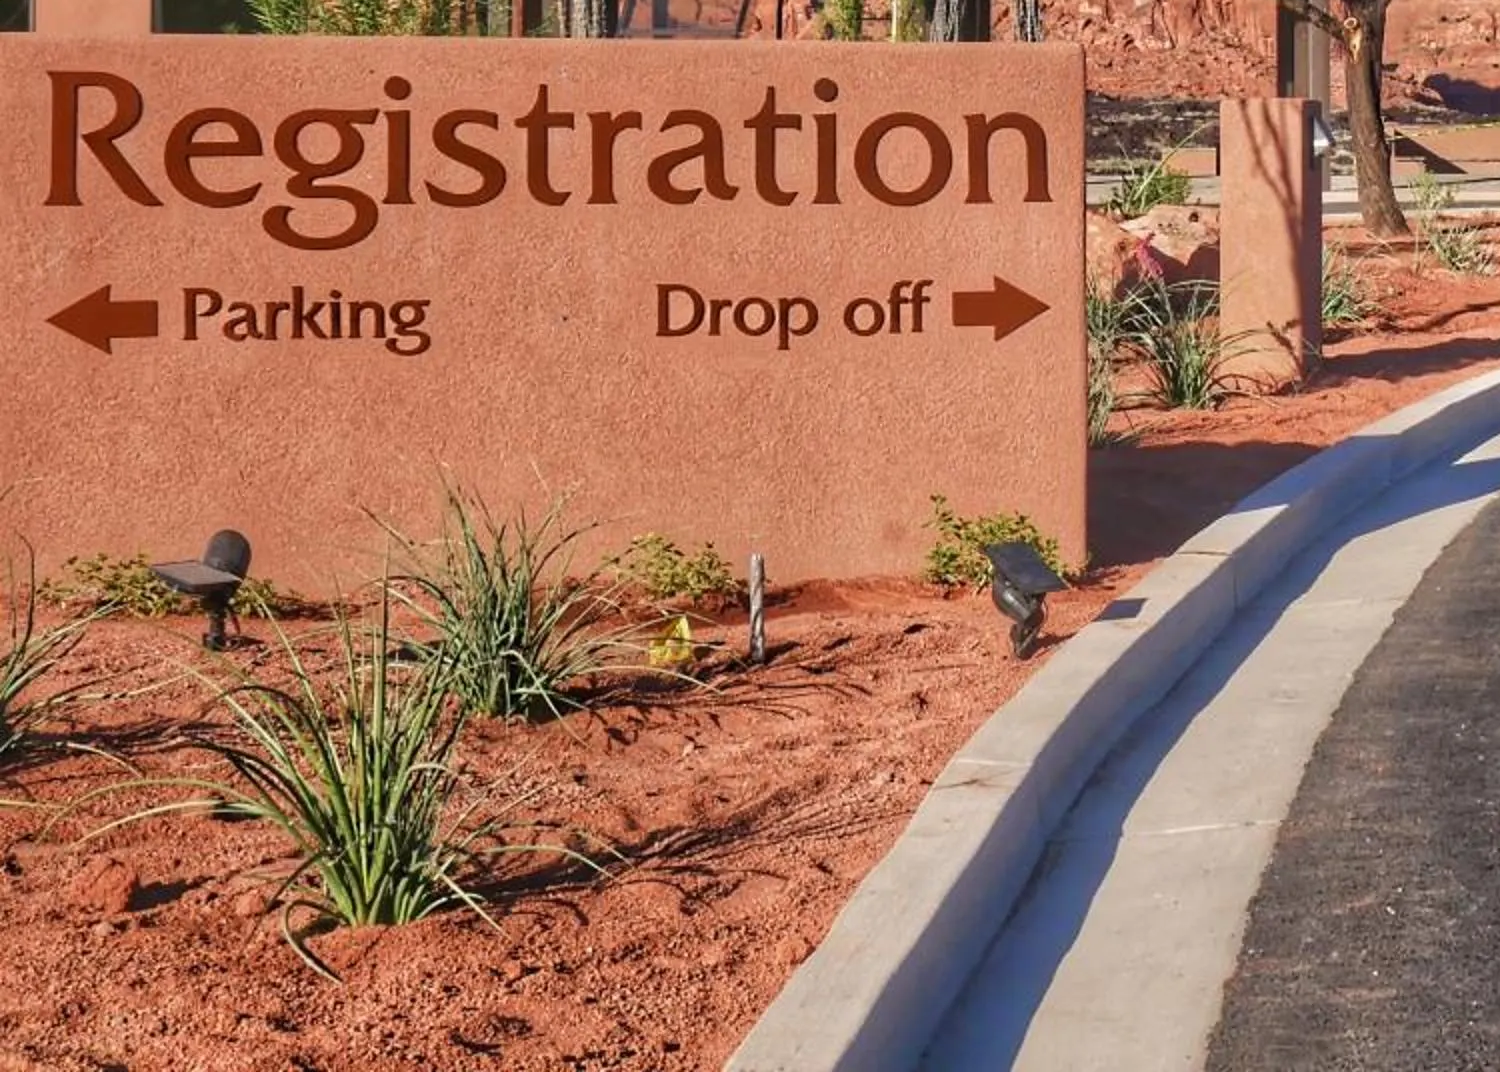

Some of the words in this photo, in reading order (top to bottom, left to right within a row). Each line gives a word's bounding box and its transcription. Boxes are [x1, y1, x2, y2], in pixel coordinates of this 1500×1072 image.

[43, 70, 1053, 251] Registration
[182, 285, 432, 357] Parking
[655, 283, 820, 351] Drop
[842, 279, 934, 338] off
